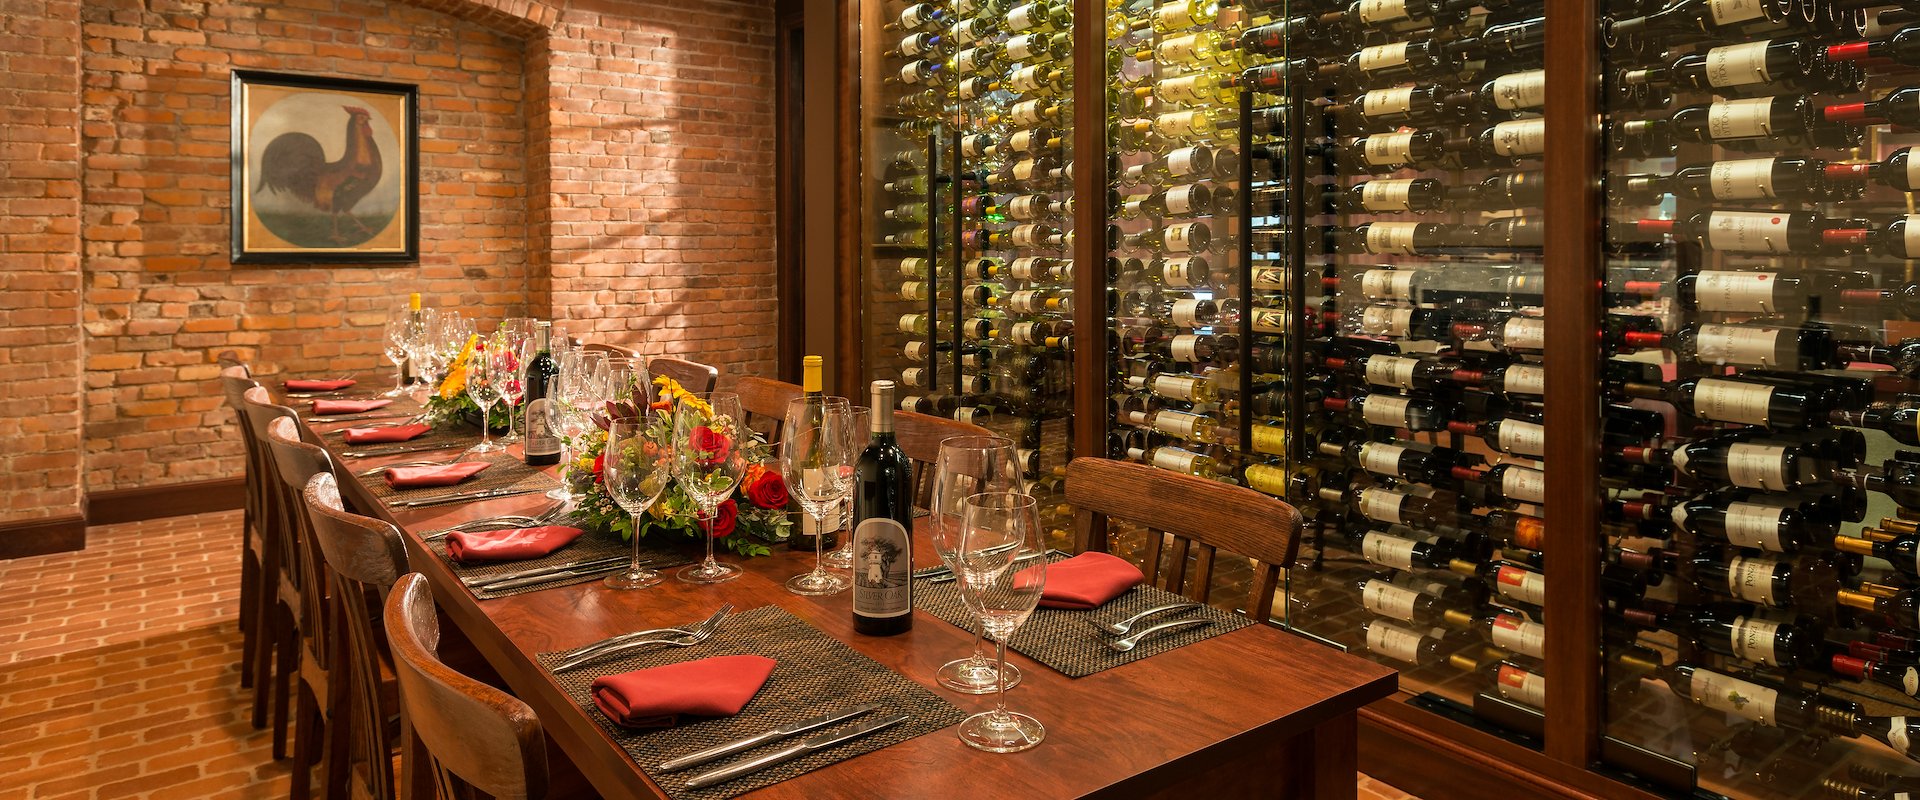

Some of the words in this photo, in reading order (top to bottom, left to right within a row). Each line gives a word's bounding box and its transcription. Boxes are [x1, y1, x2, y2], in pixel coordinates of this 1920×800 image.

[1745, 563, 1756, 588] PONZI
[859, 589, 884, 601] SILVER
[884, 590, 903, 600] OAK
[1747, 625, 1758, 650] PONZI
